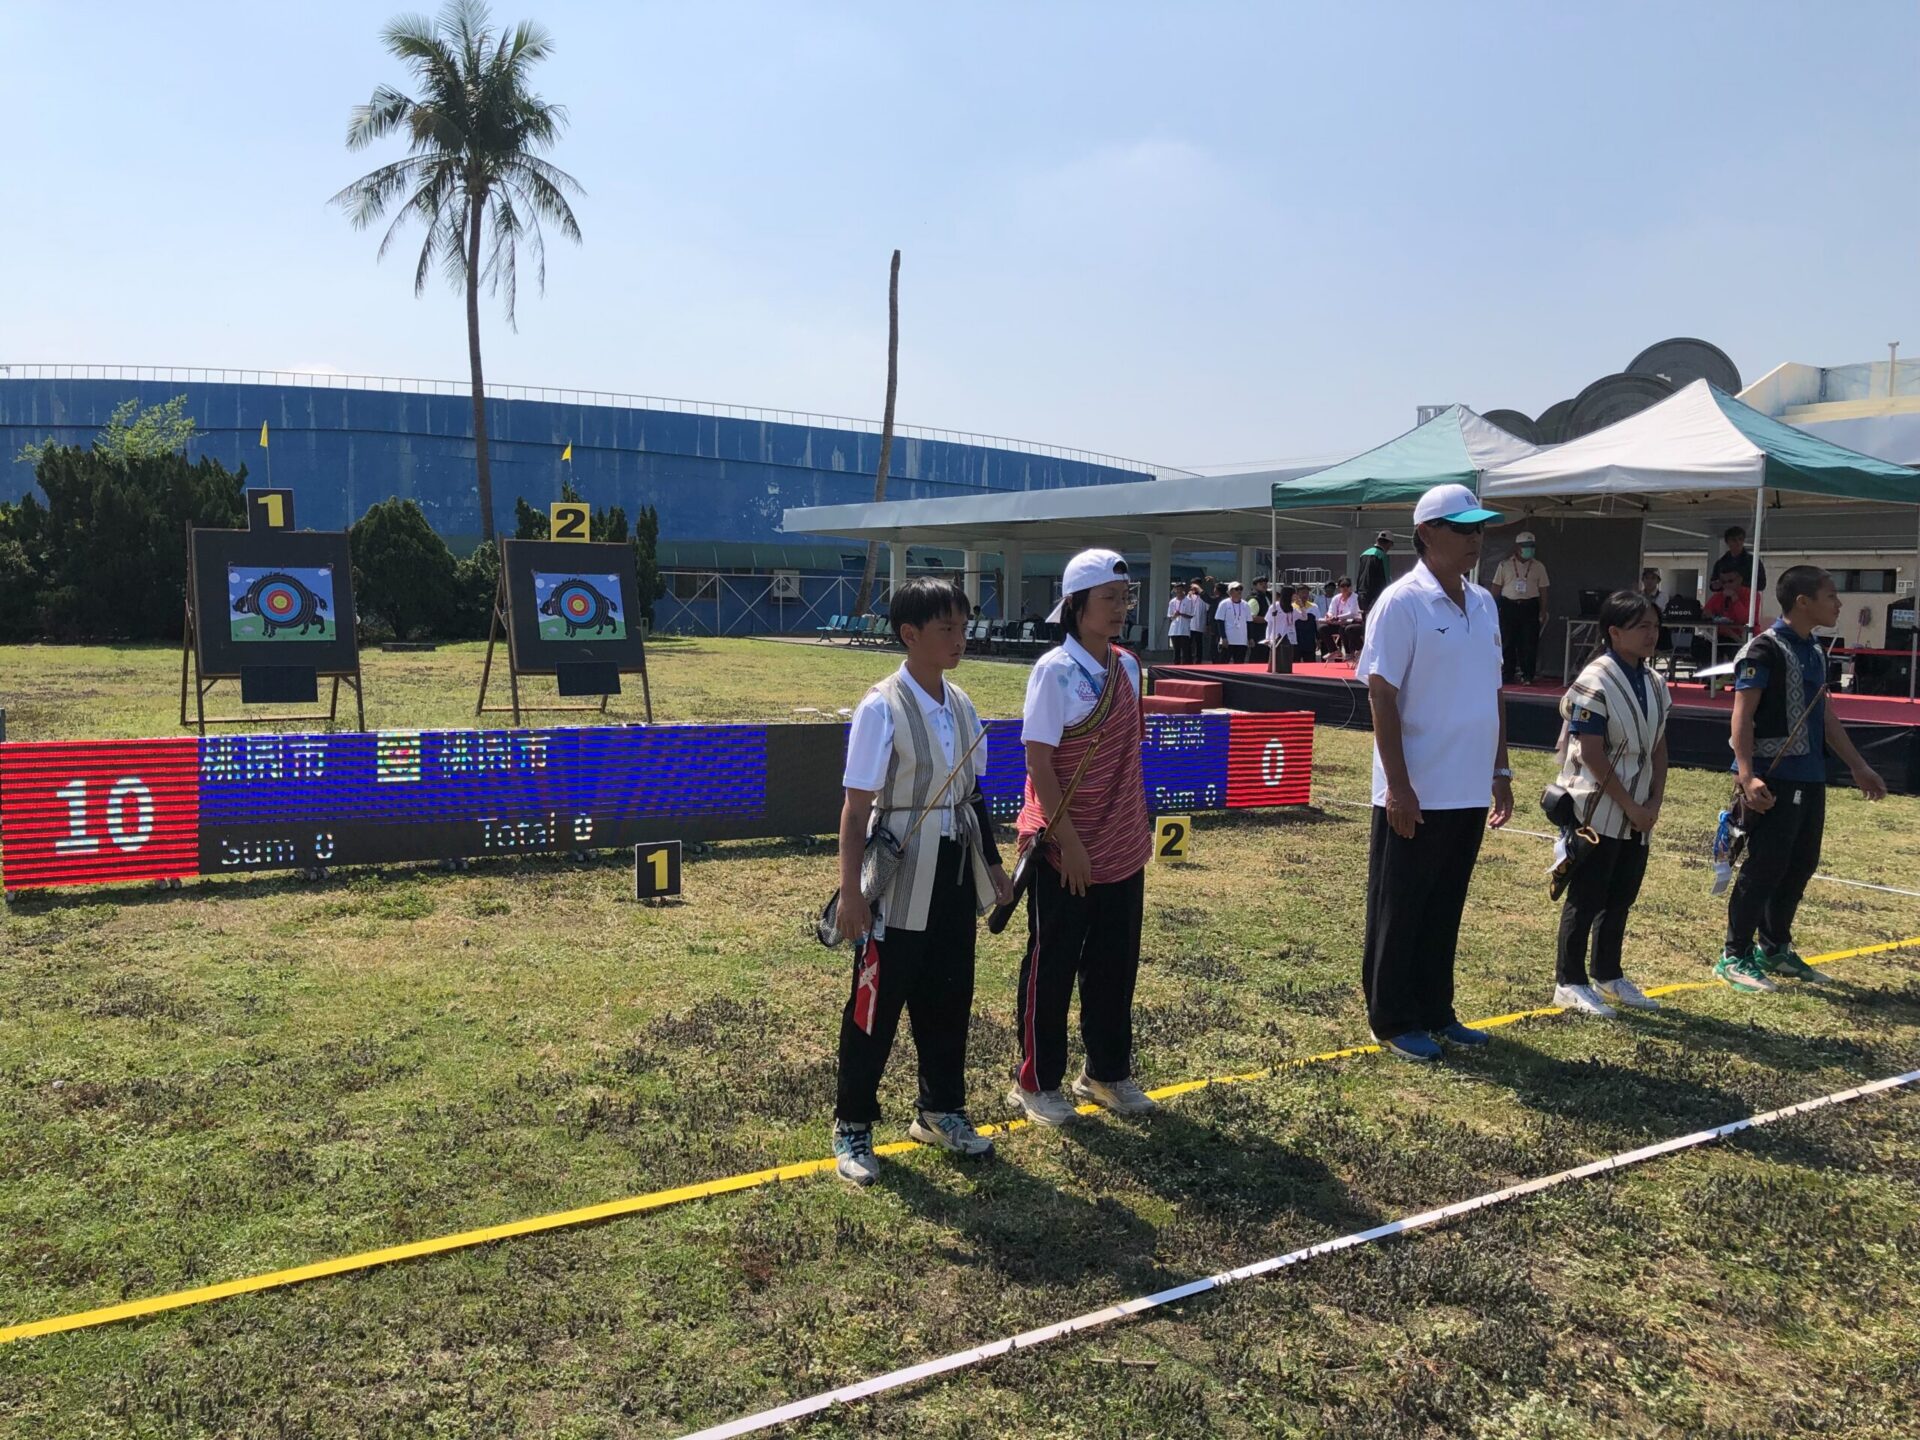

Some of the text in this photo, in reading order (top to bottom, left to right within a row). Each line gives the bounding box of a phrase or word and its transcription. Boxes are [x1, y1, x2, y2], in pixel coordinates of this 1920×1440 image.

[258, 494, 284, 527] 1
[556, 508, 585, 538] 2
[1262, 738, 1285, 786] 0
[1156, 784, 1216, 809] Sum 0
[55, 777, 155, 854] 10
[477, 811, 593, 847] Total 0
[221, 833, 335, 864] Sum 0
[1160, 823, 1184, 856] 2
[647, 850, 669, 890] 1
